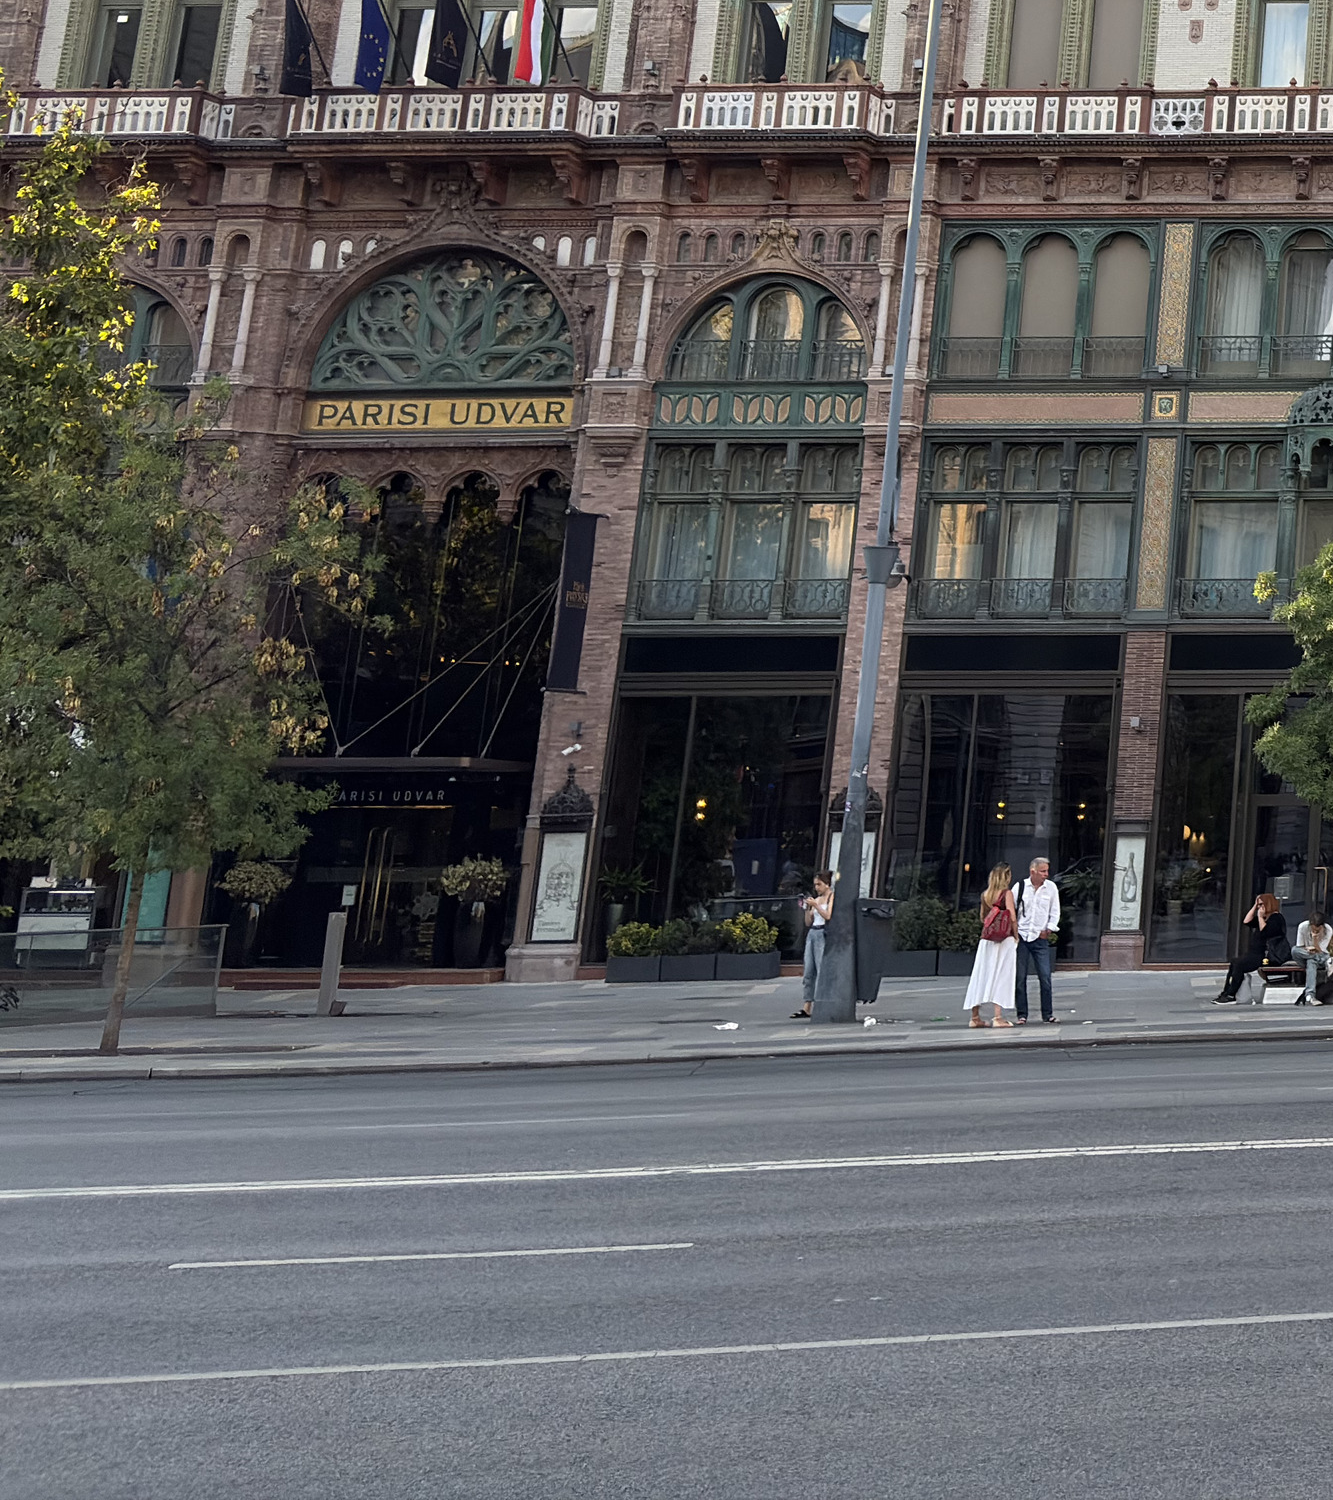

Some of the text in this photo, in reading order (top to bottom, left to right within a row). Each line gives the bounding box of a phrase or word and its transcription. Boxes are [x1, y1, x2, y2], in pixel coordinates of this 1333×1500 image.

[317, 400, 566, 426] PÁRISI UDVAR
[393, 790, 445, 801] UDVAR
